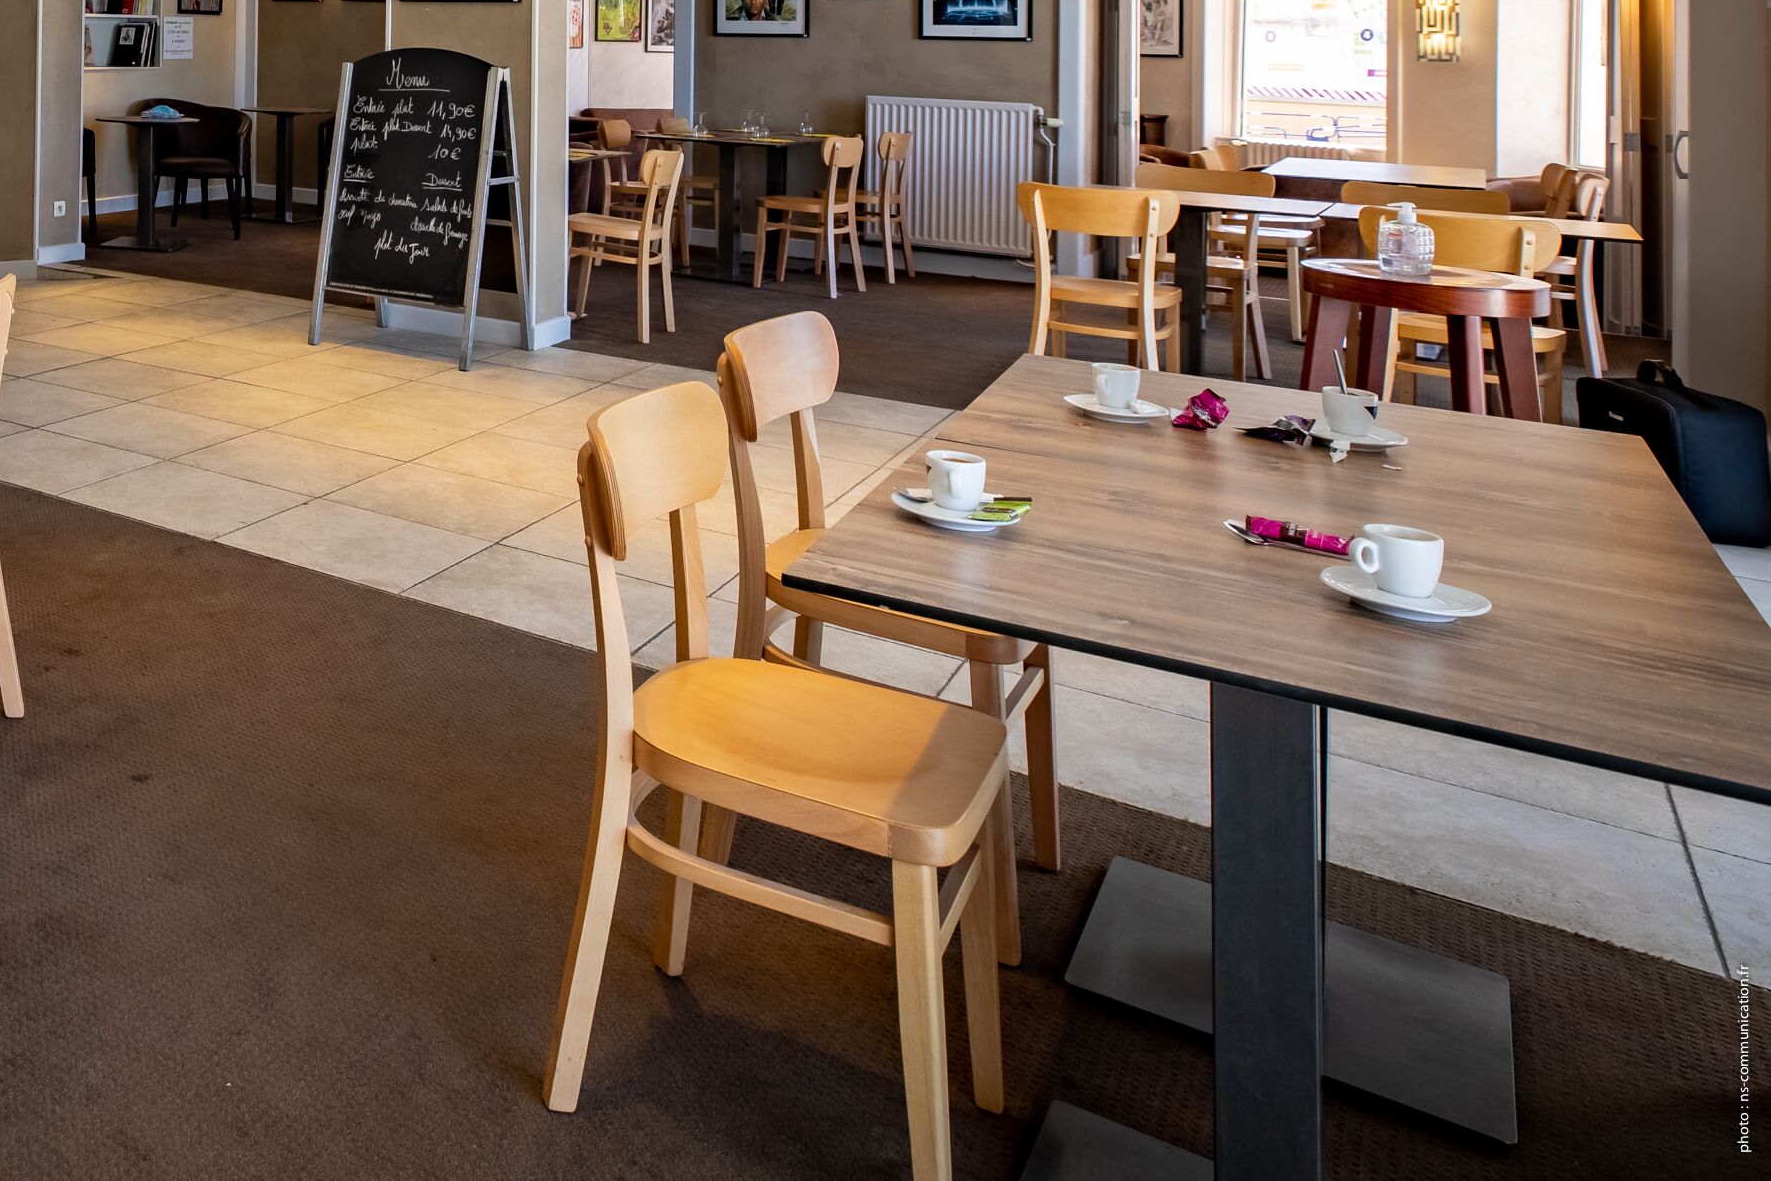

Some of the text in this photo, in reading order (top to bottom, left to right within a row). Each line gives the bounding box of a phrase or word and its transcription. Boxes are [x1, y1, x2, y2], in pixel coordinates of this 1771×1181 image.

[386, 57, 429, 89] Menu
[353, 95, 385, 114] Entrée
[392, 96, 414, 118] plat
